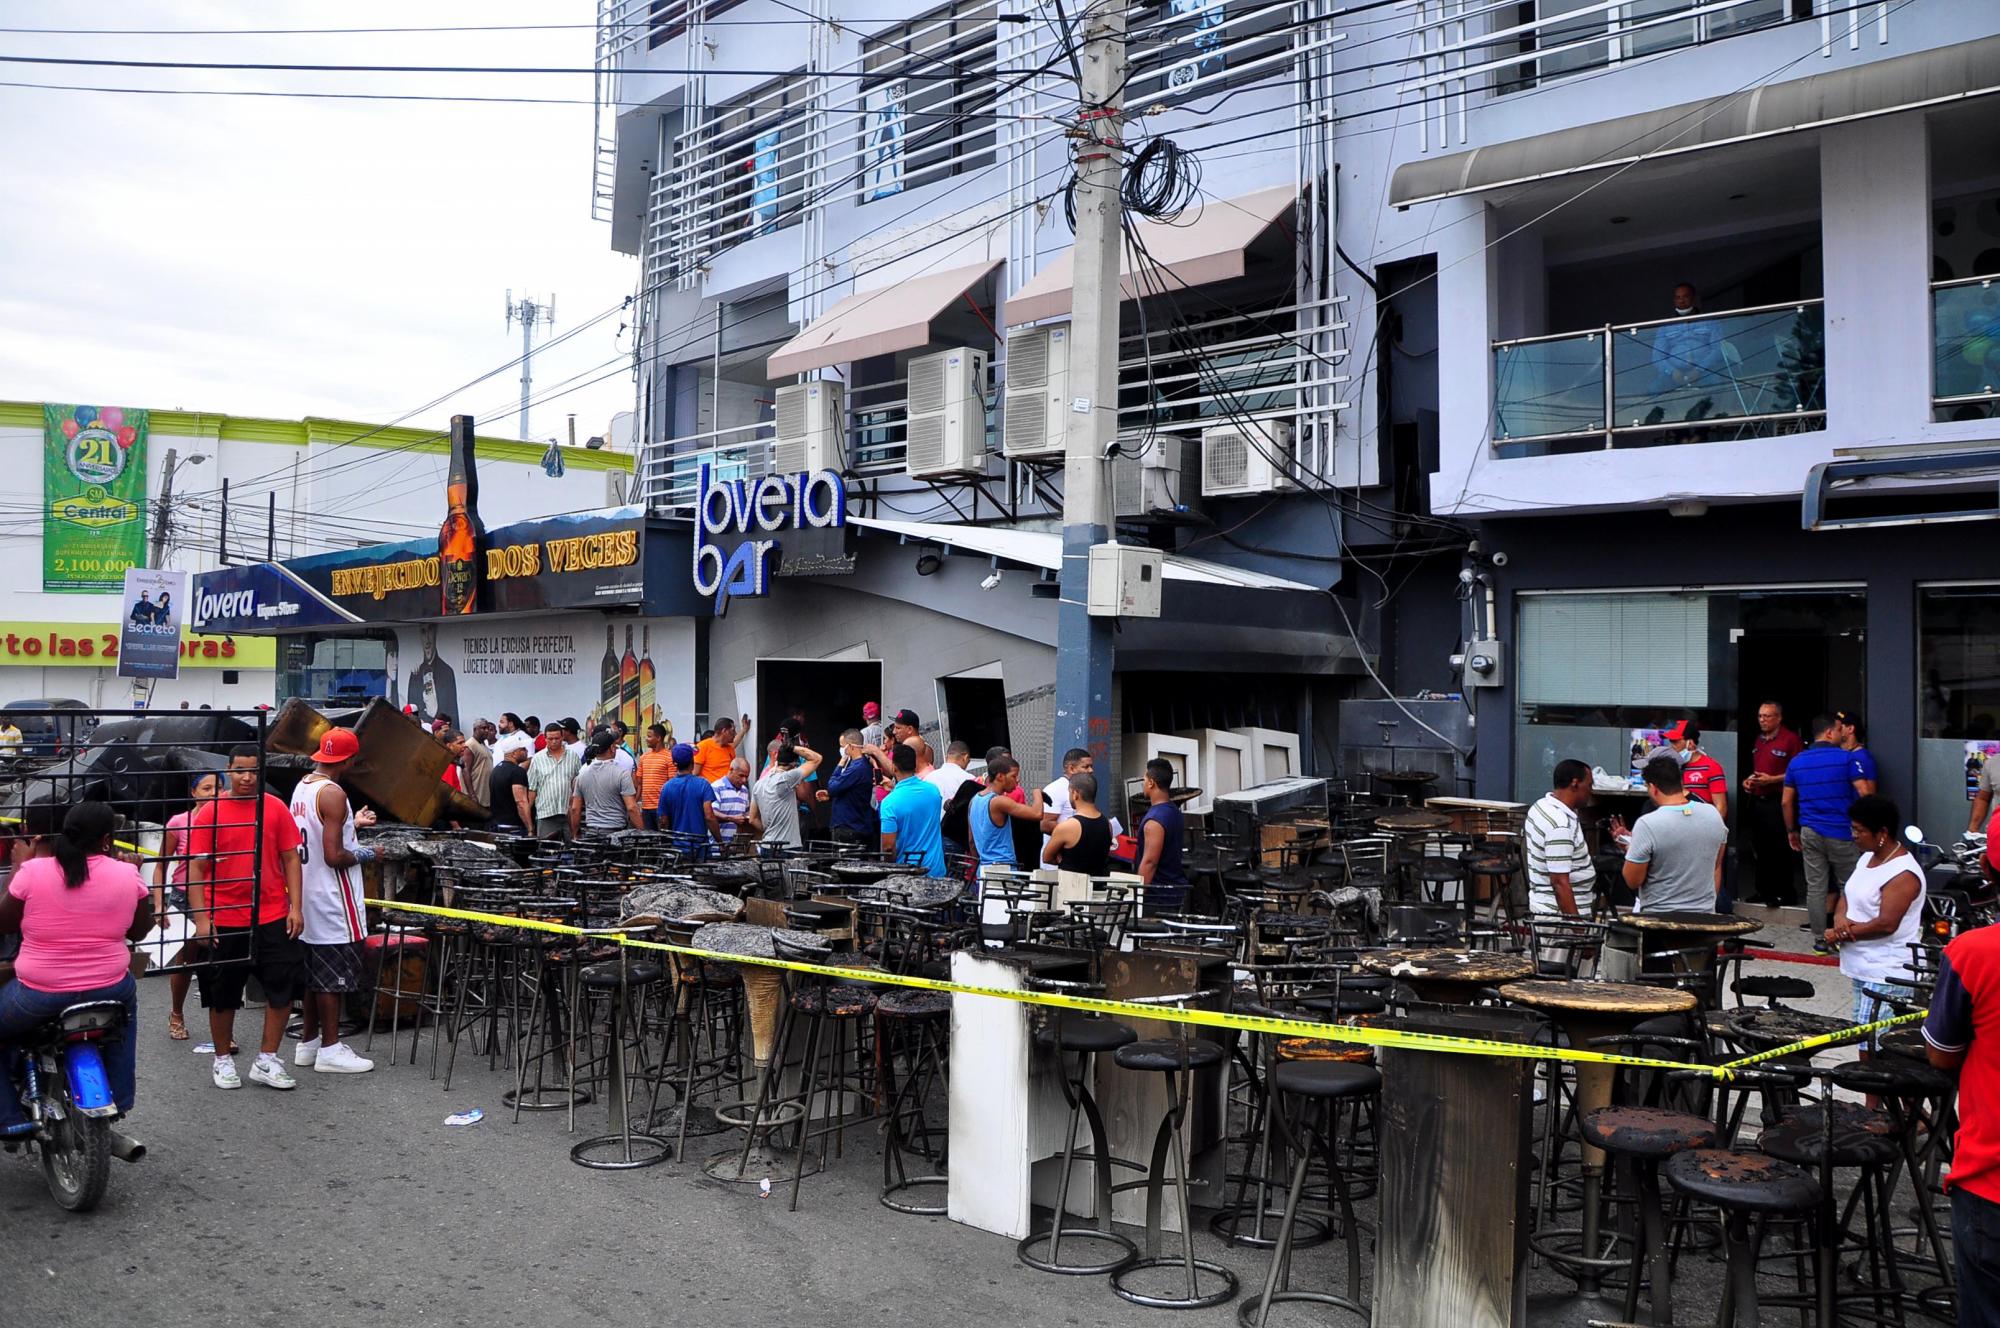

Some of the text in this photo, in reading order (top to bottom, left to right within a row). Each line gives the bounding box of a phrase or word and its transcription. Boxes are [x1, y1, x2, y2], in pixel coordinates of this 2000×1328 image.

[80, 439, 113, 465] 21
[64, 505, 126, 518] Central
[486, 530, 638, 580] DOS VECES
[331, 557, 440, 600] ENVEJECIDO
[194, 587, 254, 627] Lovera
[0, 633, 42, 656] to
[49, 632, 94, 657] las
[463, 635, 576, 654] TIENES LA EXCUSA PERFECTA.
[490, 659, 504, 674] CON
[506, 658, 538, 674] JOHNNIE
